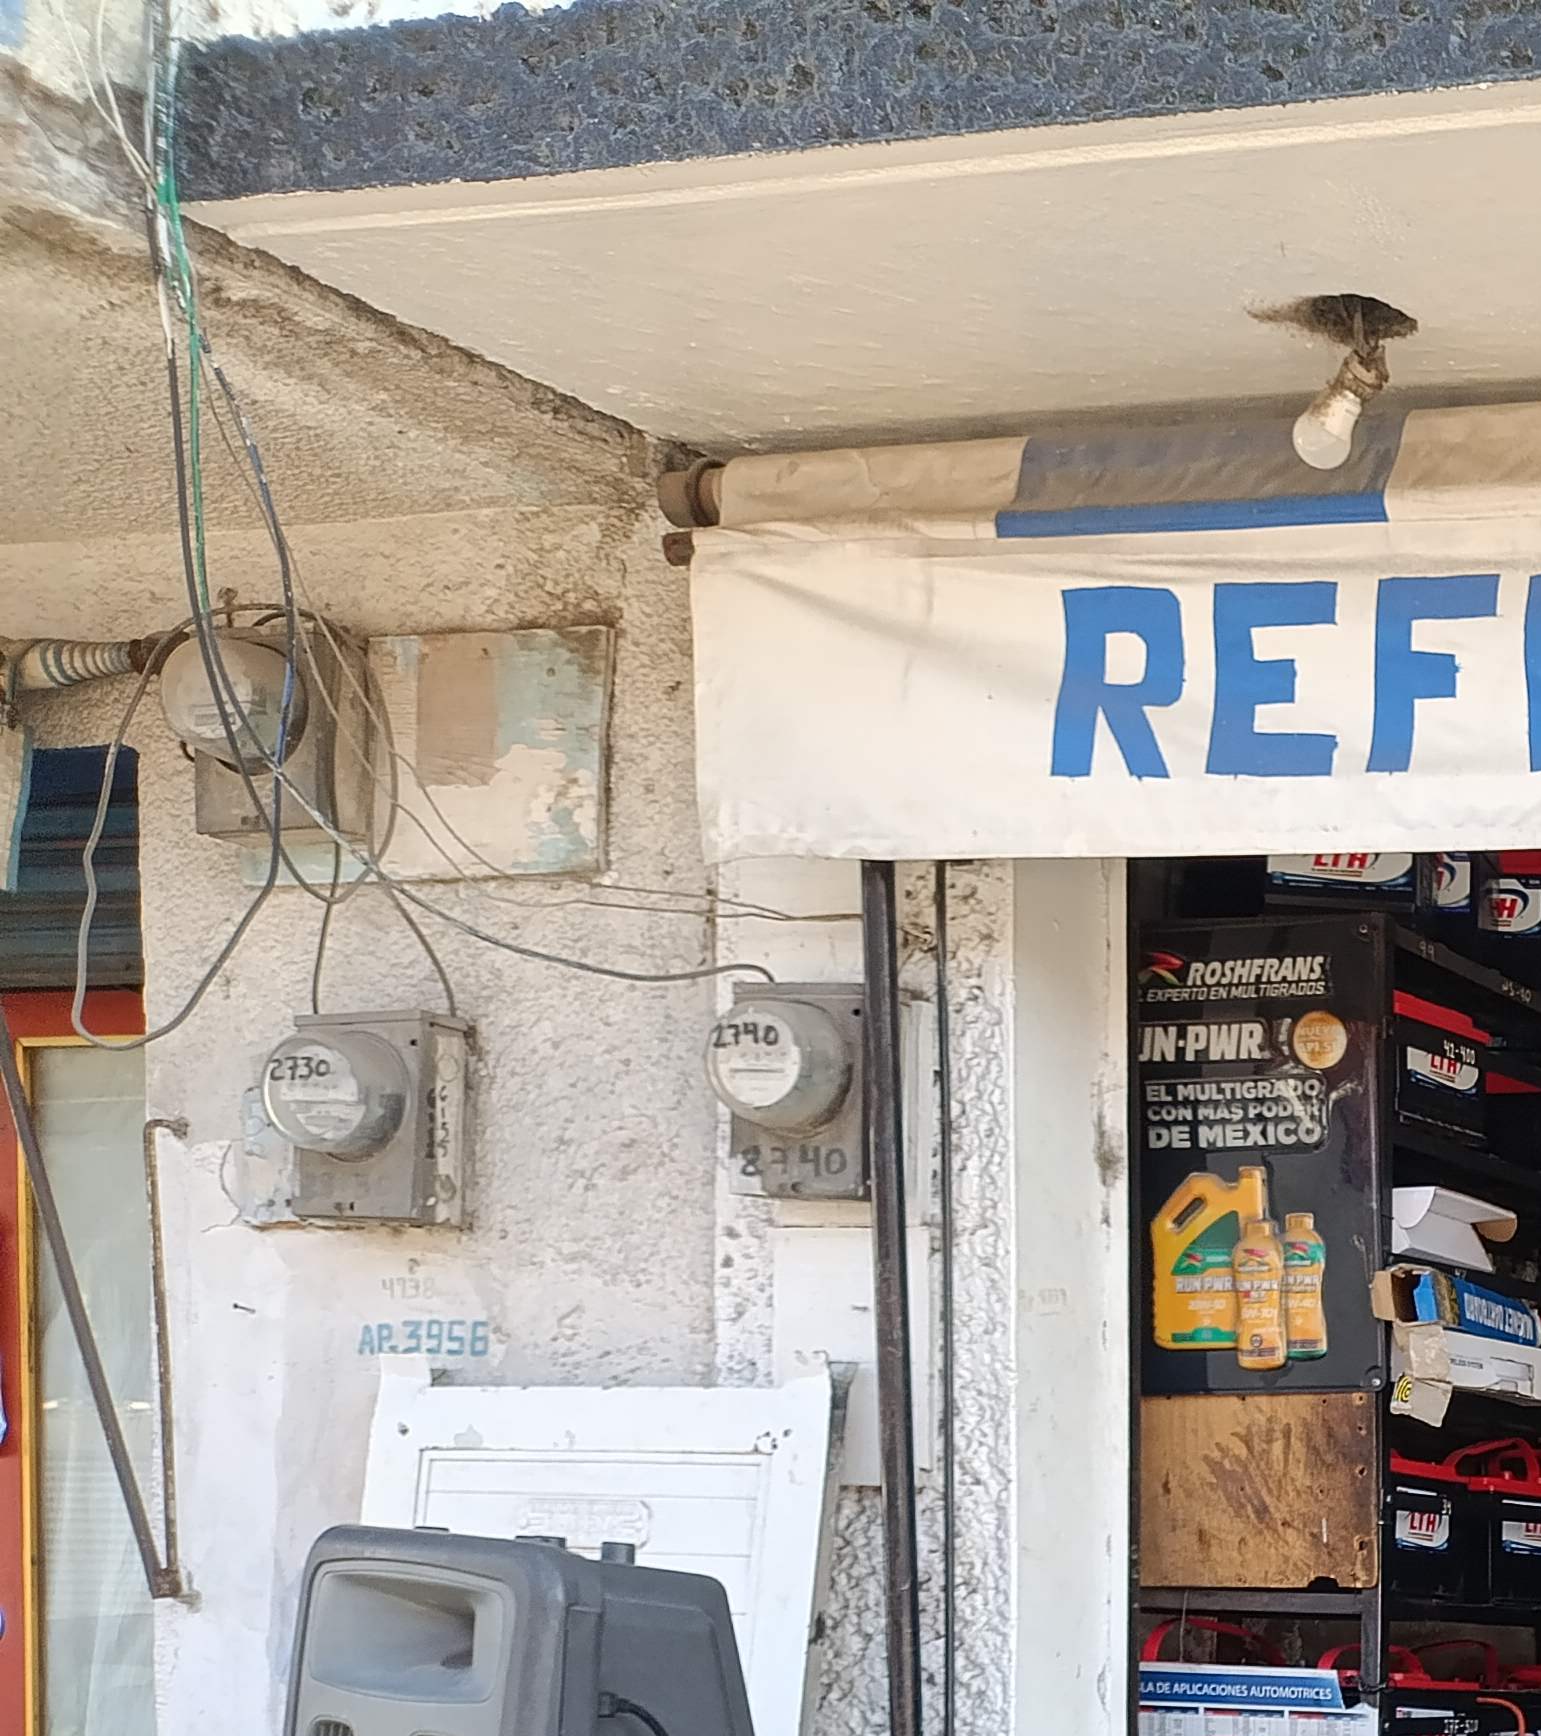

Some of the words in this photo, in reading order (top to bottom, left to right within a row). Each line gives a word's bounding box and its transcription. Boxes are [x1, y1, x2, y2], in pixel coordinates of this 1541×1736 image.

[1188, 956, 1325, 986] ROSHFRANS
[1147, 987, 1206, 1002] EXPERTO
[1210, 985, 1229, 999] EN
[1231, 981, 1325, 998] MULTIGRADOS
[270, 1056, 331, 1082] 2730
[1146, 1085, 1172, 1102] EL
[1177, 1078, 1321, 1102] MULTIGRADO
[1147, 1104, 1193, 1122] CON
[1197, 1099, 1244, 1121] MÁS
[1248, 1101, 1320, 1118] PODER
[1148, 1125, 1192, 1149] DE
[1157, 1682, 1171, 1694] DE
[1173, 1683, 1248, 1697] APLICACIONES
[1250, 1685, 1332, 1700] AUTOMOTRICES
